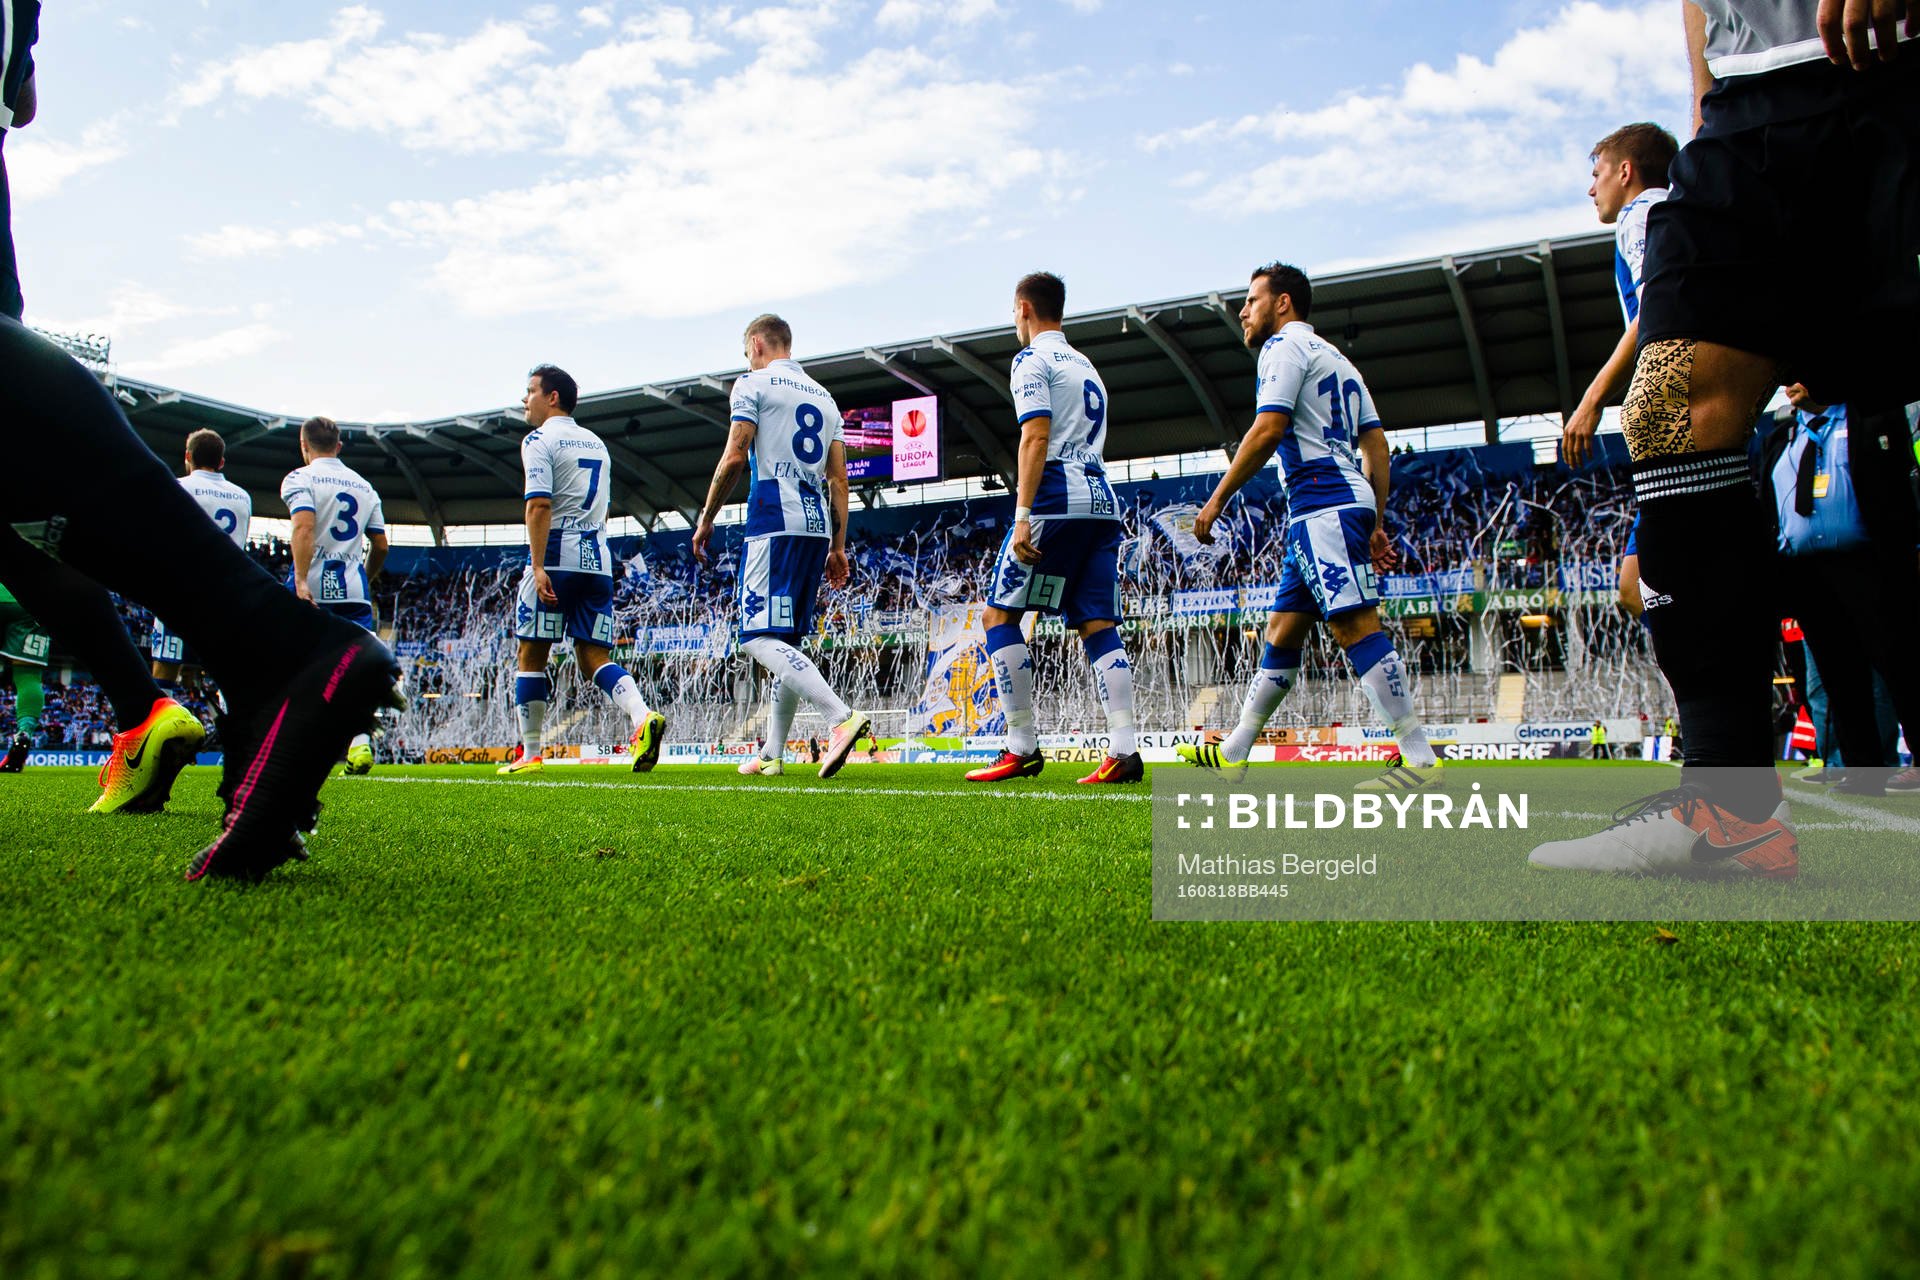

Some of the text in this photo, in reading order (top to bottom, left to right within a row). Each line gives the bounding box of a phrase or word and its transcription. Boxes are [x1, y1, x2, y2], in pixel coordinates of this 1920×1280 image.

[1083, 379, 1105, 446] 9
[1318, 371, 1362, 449] 10
[792, 403, 824, 465] 8
[895, 450, 934, 462] EUROPA
[903, 461, 926, 469] LEAGUE
[578, 458, 602, 510] 7
[1092, 488, 1107, 501] RN
[803, 497, 816, 509] SE
[1092, 500, 1112, 514] EKE
[330, 492, 359, 541] 3
[806, 508, 820, 520] RN
[808, 520, 824, 533] EKE
[580, 539, 593, 550] SE
[581, 549, 596, 560] RN
[581, 559, 600, 570] EKE
[323, 570, 337, 580] SE
[323, 580, 339, 589] RN
[323, 589, 345, 599] EKE
[1519, 726, 1593, 739] clean par
[1300, 745, 1393, 761] Scandic
[1443, 743, 1553, 760] SERNEKE
